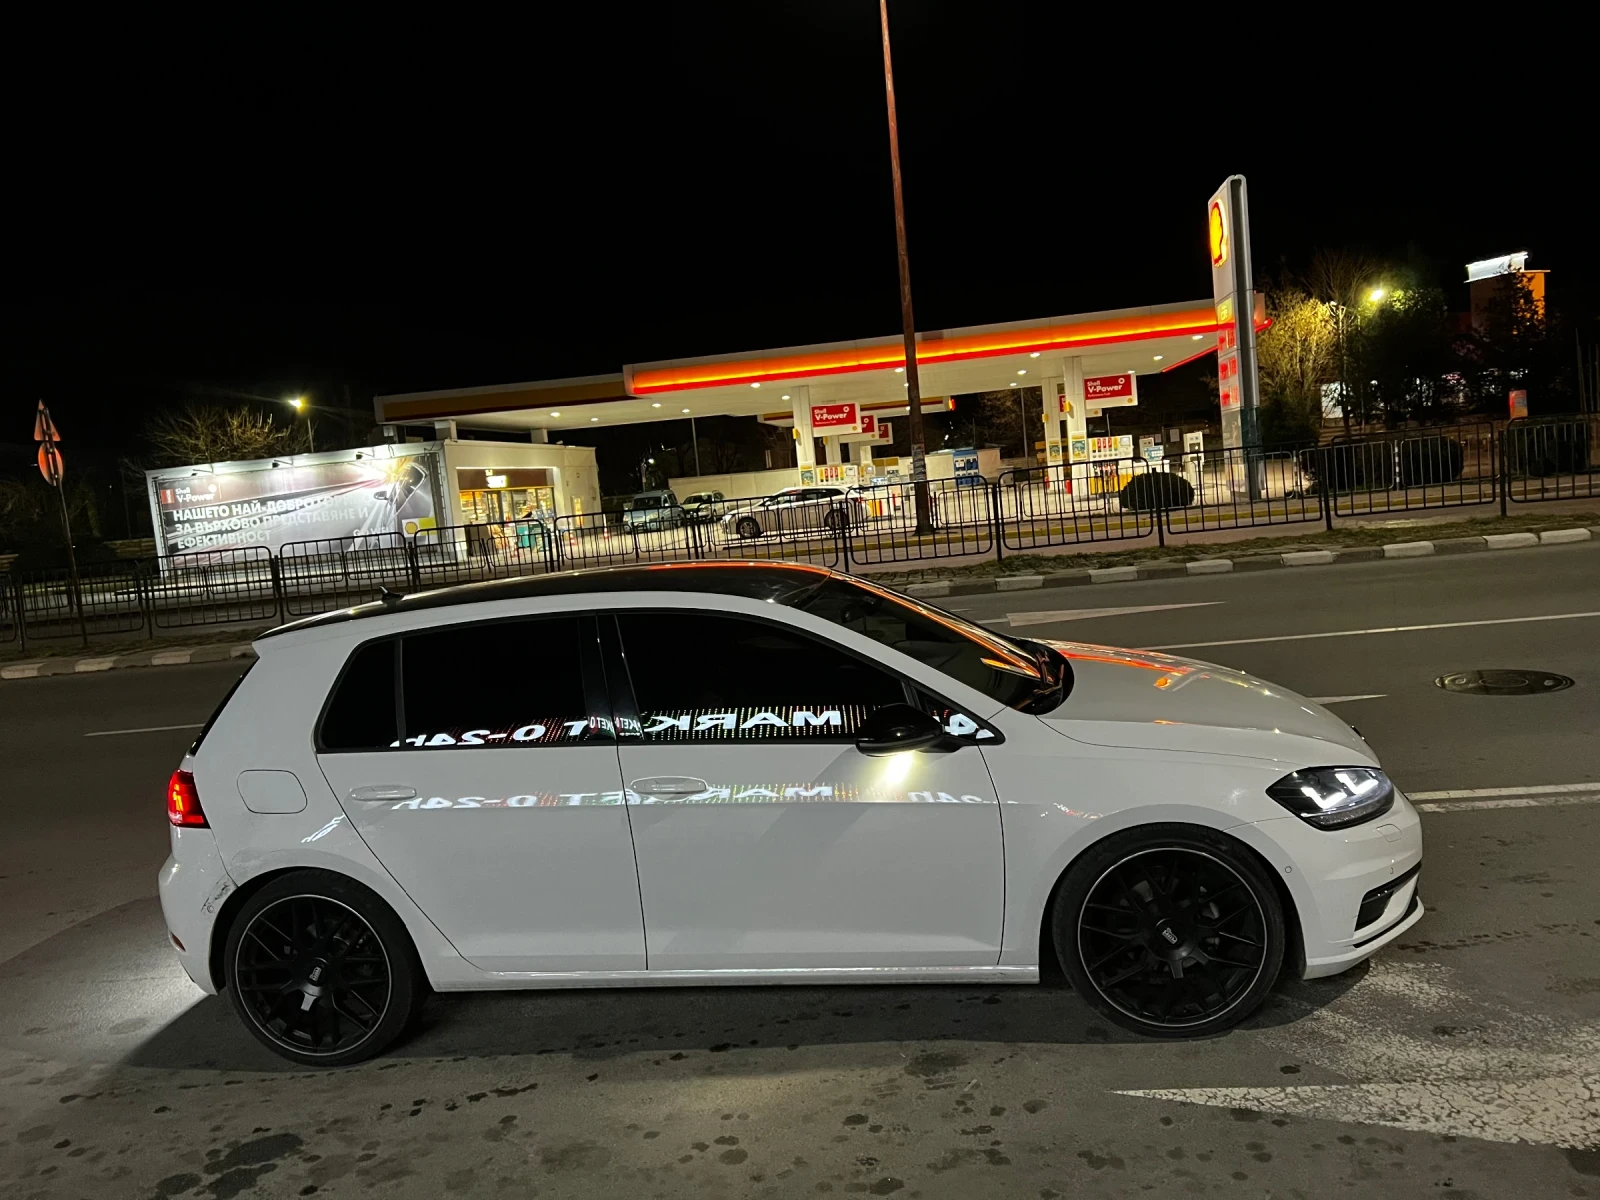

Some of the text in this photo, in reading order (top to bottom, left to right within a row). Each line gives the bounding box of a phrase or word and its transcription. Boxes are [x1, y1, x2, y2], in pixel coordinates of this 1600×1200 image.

[1088, 385, 1122, 393] V-Power
[815, 413, 847, 421] V-Power
[175, 487, 191, 495] Shell
[176, 493, 215, 503] V-Power
[173, 505, 230, 521] НАШЕТО
[195, 517, 260, 533] ВЪРХОВО
[263, 508, 356, 526] ПРЕДСТАВЯНЕ
[359, 506, 369, 519] И
[177, 530, 272, 548] ЕФЕКТИВНОСТ
